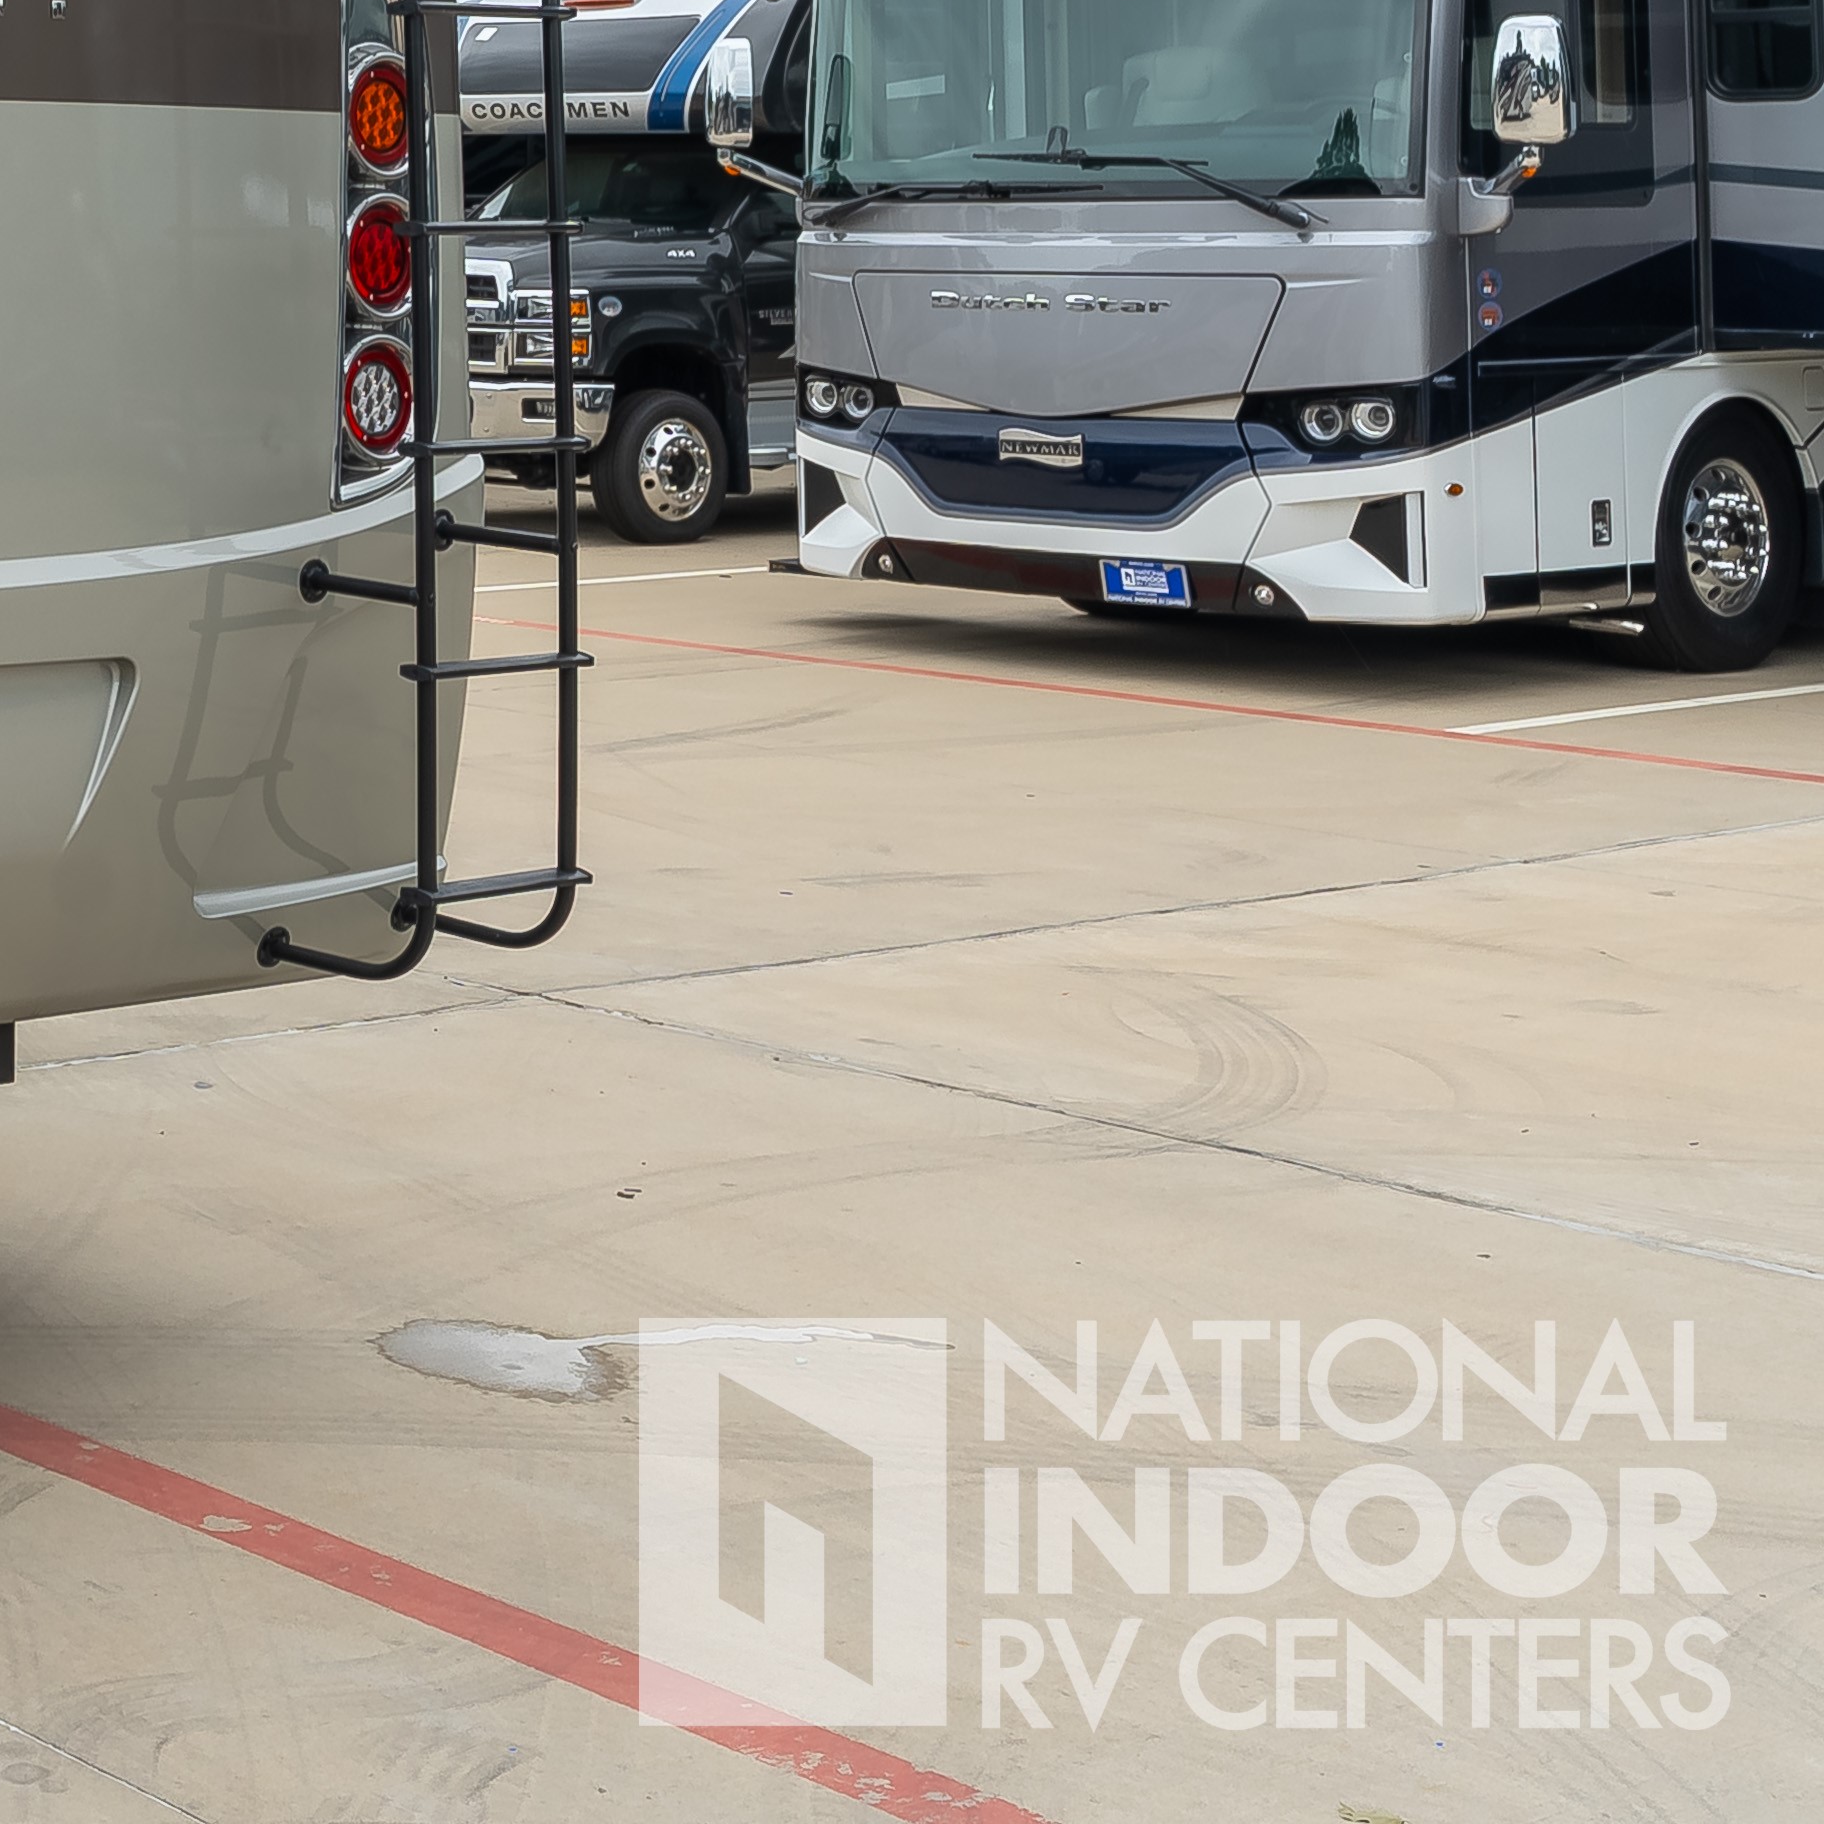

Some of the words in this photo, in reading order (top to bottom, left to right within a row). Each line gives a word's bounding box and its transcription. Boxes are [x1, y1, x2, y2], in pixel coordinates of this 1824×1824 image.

[471, 101, 630, 120] COACMEN
[931, 290, 1050, 311] Dutch
[1064, 294, 1171, 313] Star
[1002, 441, 1079, 455] NEWMAR
